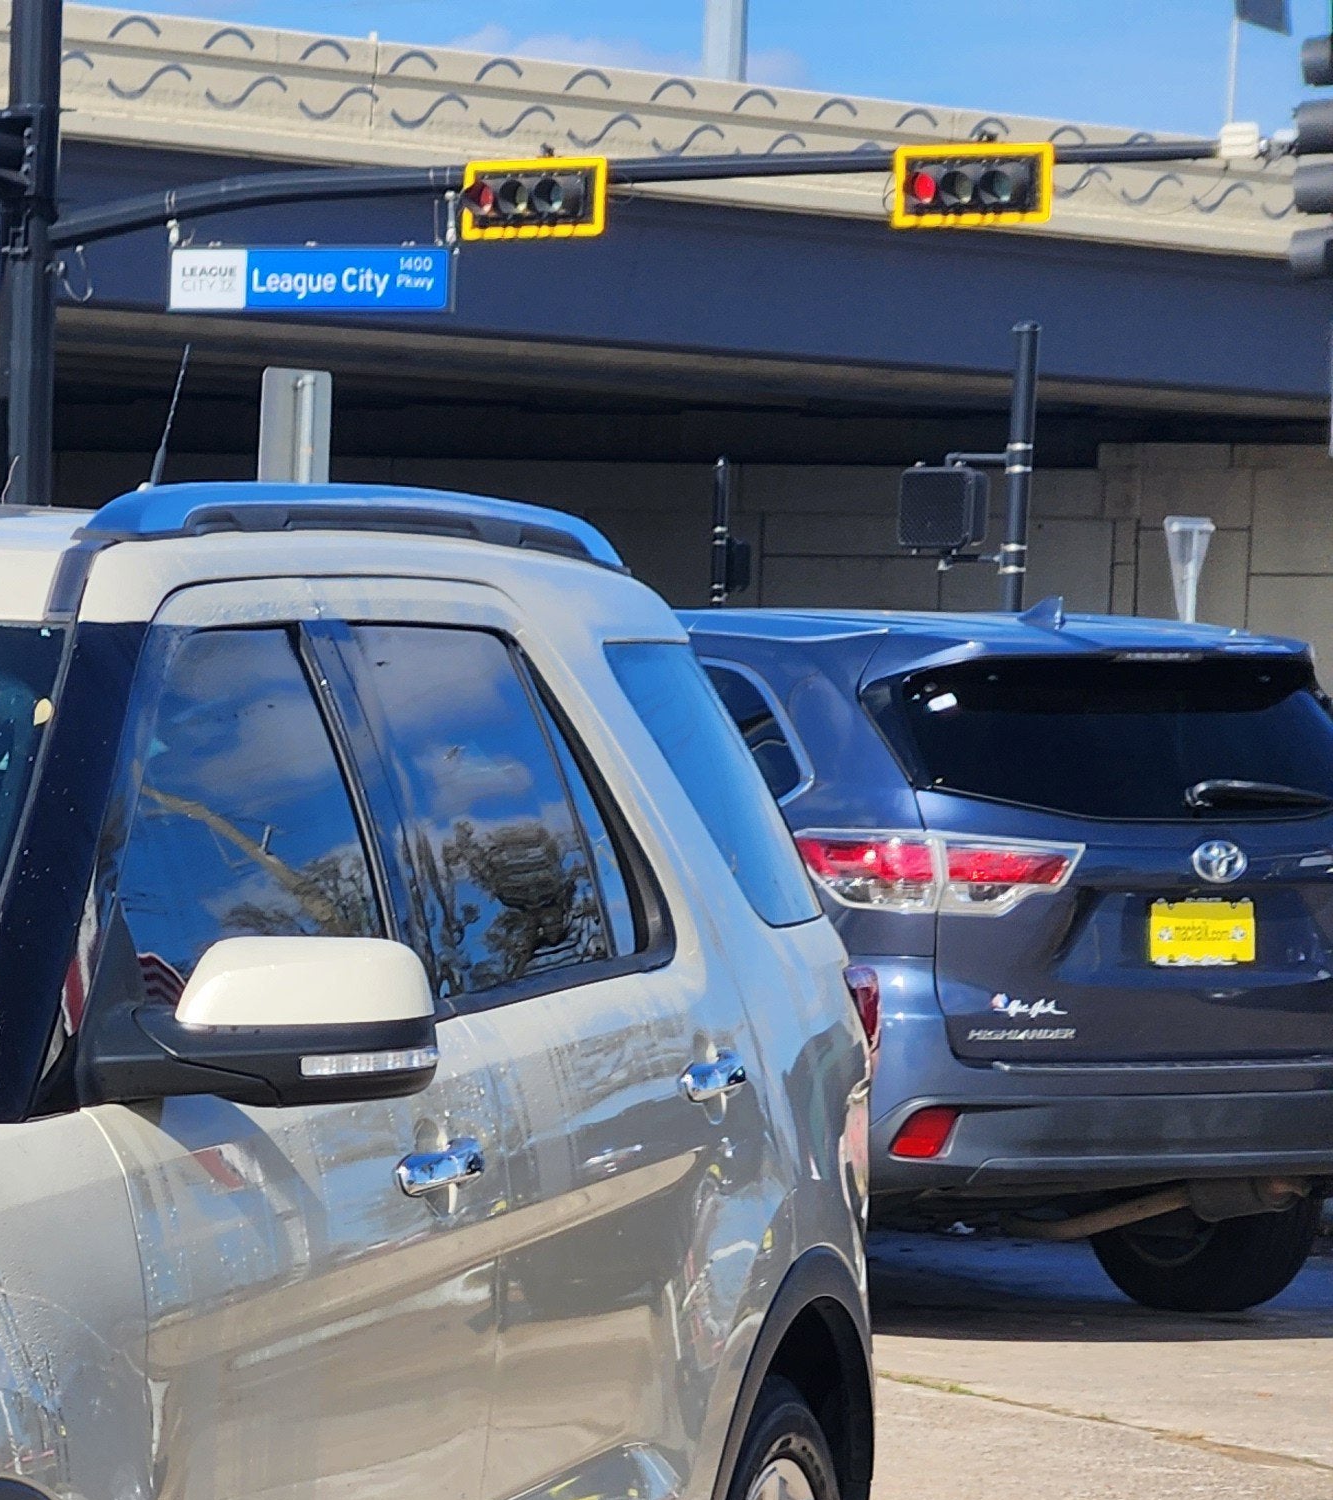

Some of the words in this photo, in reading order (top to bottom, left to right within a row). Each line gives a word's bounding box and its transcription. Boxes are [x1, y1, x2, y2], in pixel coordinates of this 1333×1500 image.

[181, 265, 237, 278] LEAGUE
[399, 256, 433, 272] 1400
[180, 279, 216, 293] CITY
[251, 267, 337, 300] League
[341, 266, 390, 298] City
[396, 274, 435, 291] Pkwy
